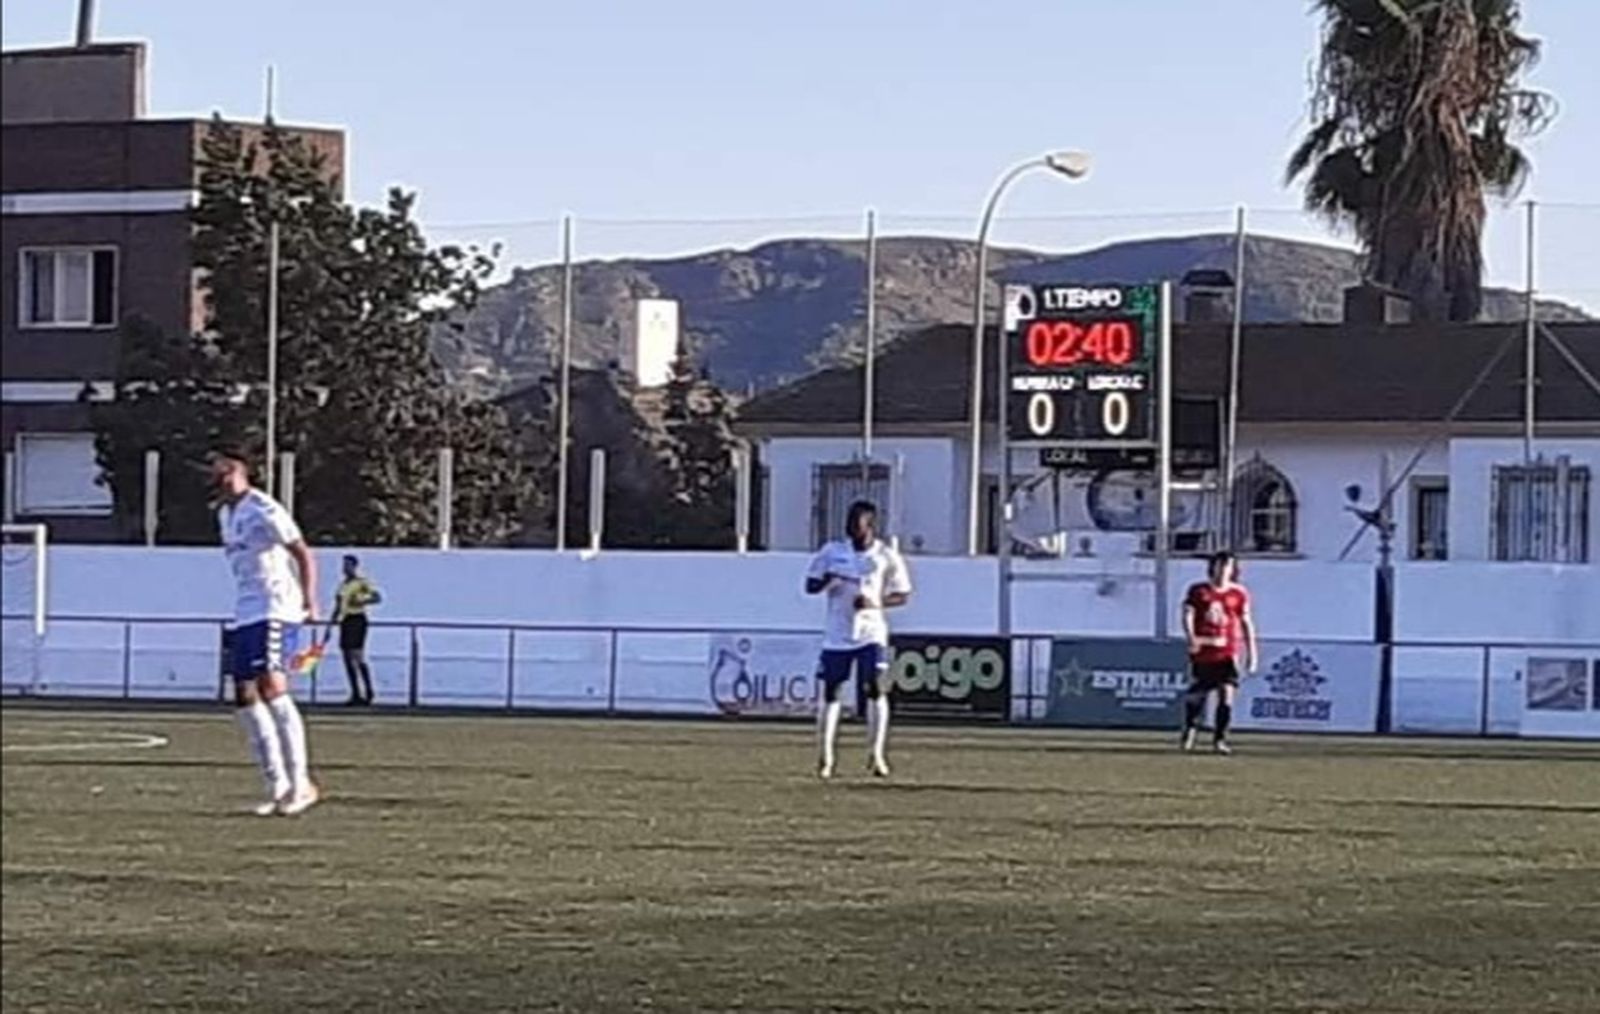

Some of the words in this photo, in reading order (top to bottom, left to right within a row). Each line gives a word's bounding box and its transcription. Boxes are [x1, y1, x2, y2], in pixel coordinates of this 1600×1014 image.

[1028, 392, 1054, 436] 0
[1103, 392, 1129, 436] 0
[1091, 670, 1191, 690] ESTRELL
